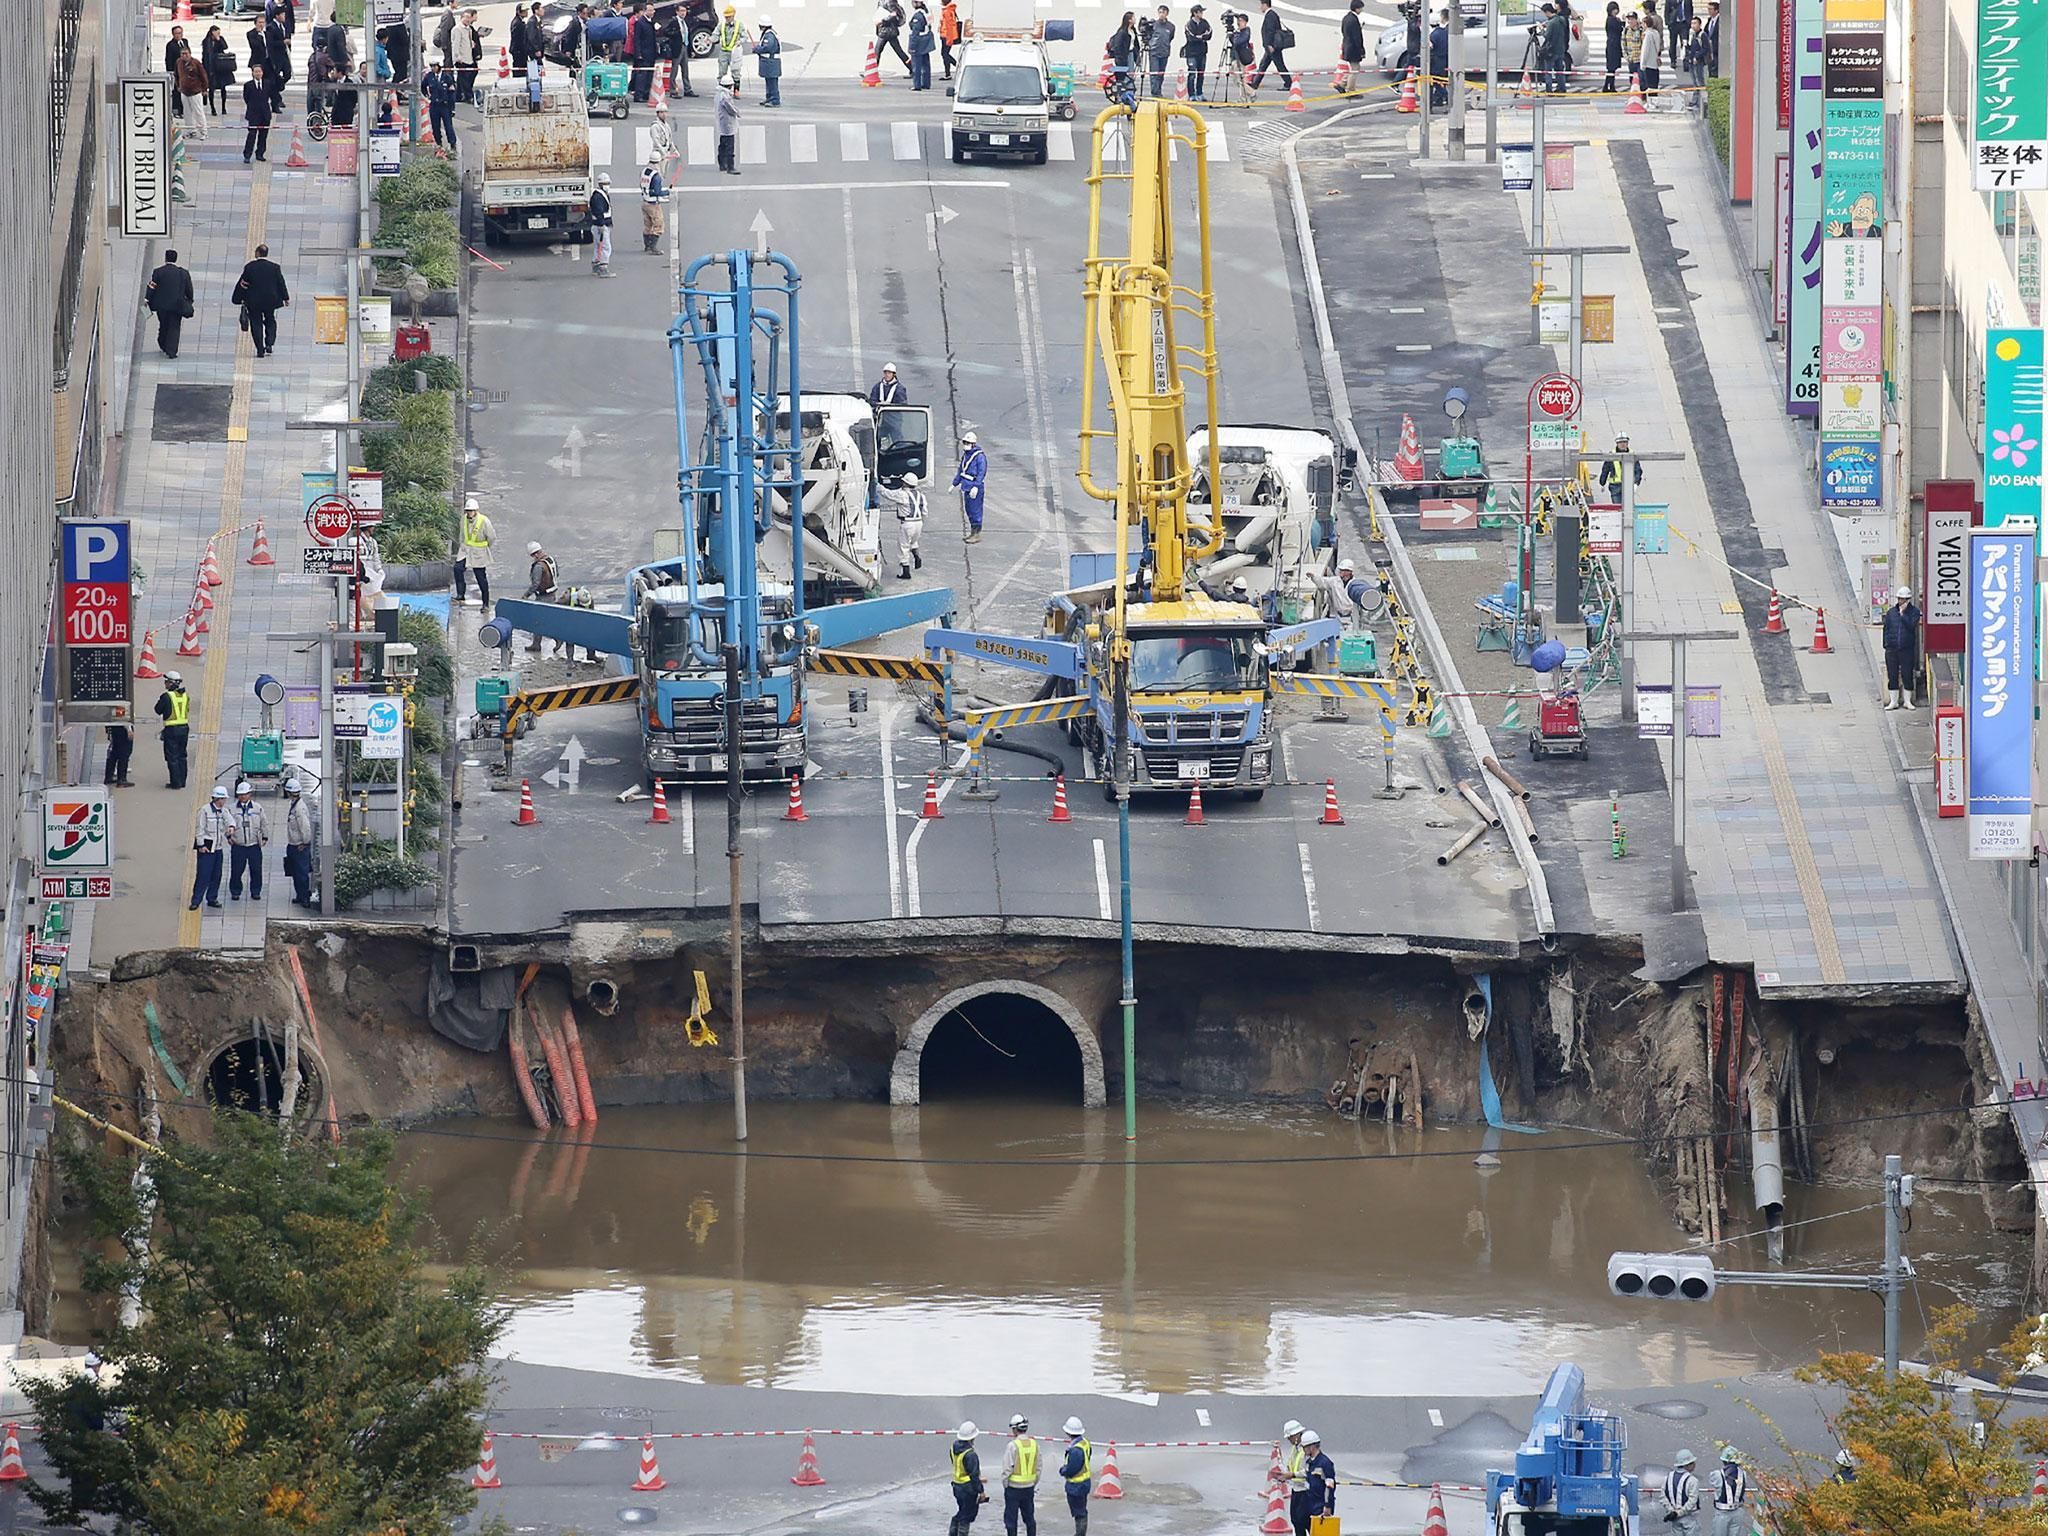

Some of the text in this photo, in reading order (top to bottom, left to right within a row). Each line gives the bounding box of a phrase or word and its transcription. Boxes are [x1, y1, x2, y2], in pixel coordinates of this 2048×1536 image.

[1826, 125, 1881, 137] エステートプラザ
[133, 87, 157, 230] BEST BRIDAL
[1979, 145, 2043, 165] 整体
[1990, 169, 2025, 186] 7F
[1541, 390, 1572, 405] 消火栓
[1989, 475, 2011, 487] IYO
[317, 513, 348, 528] 消火栓
[75, 526, 119, 581] P
[304, 549, 354, 561] とみや歯科
[1937, 536, 1961, 598] VELOCE
[75, 587, 118, 607] 20分
[2012, 544, 2023, 676] Dramatic Communication
[68, 609, 127, 640] 100円
[1981, 544, 2009, 718] アパマンショップ
[43, 881, 64, 896] ATM
[69, 880, 84, 896] 酒
[89, 880, 110, 895] たばこ
